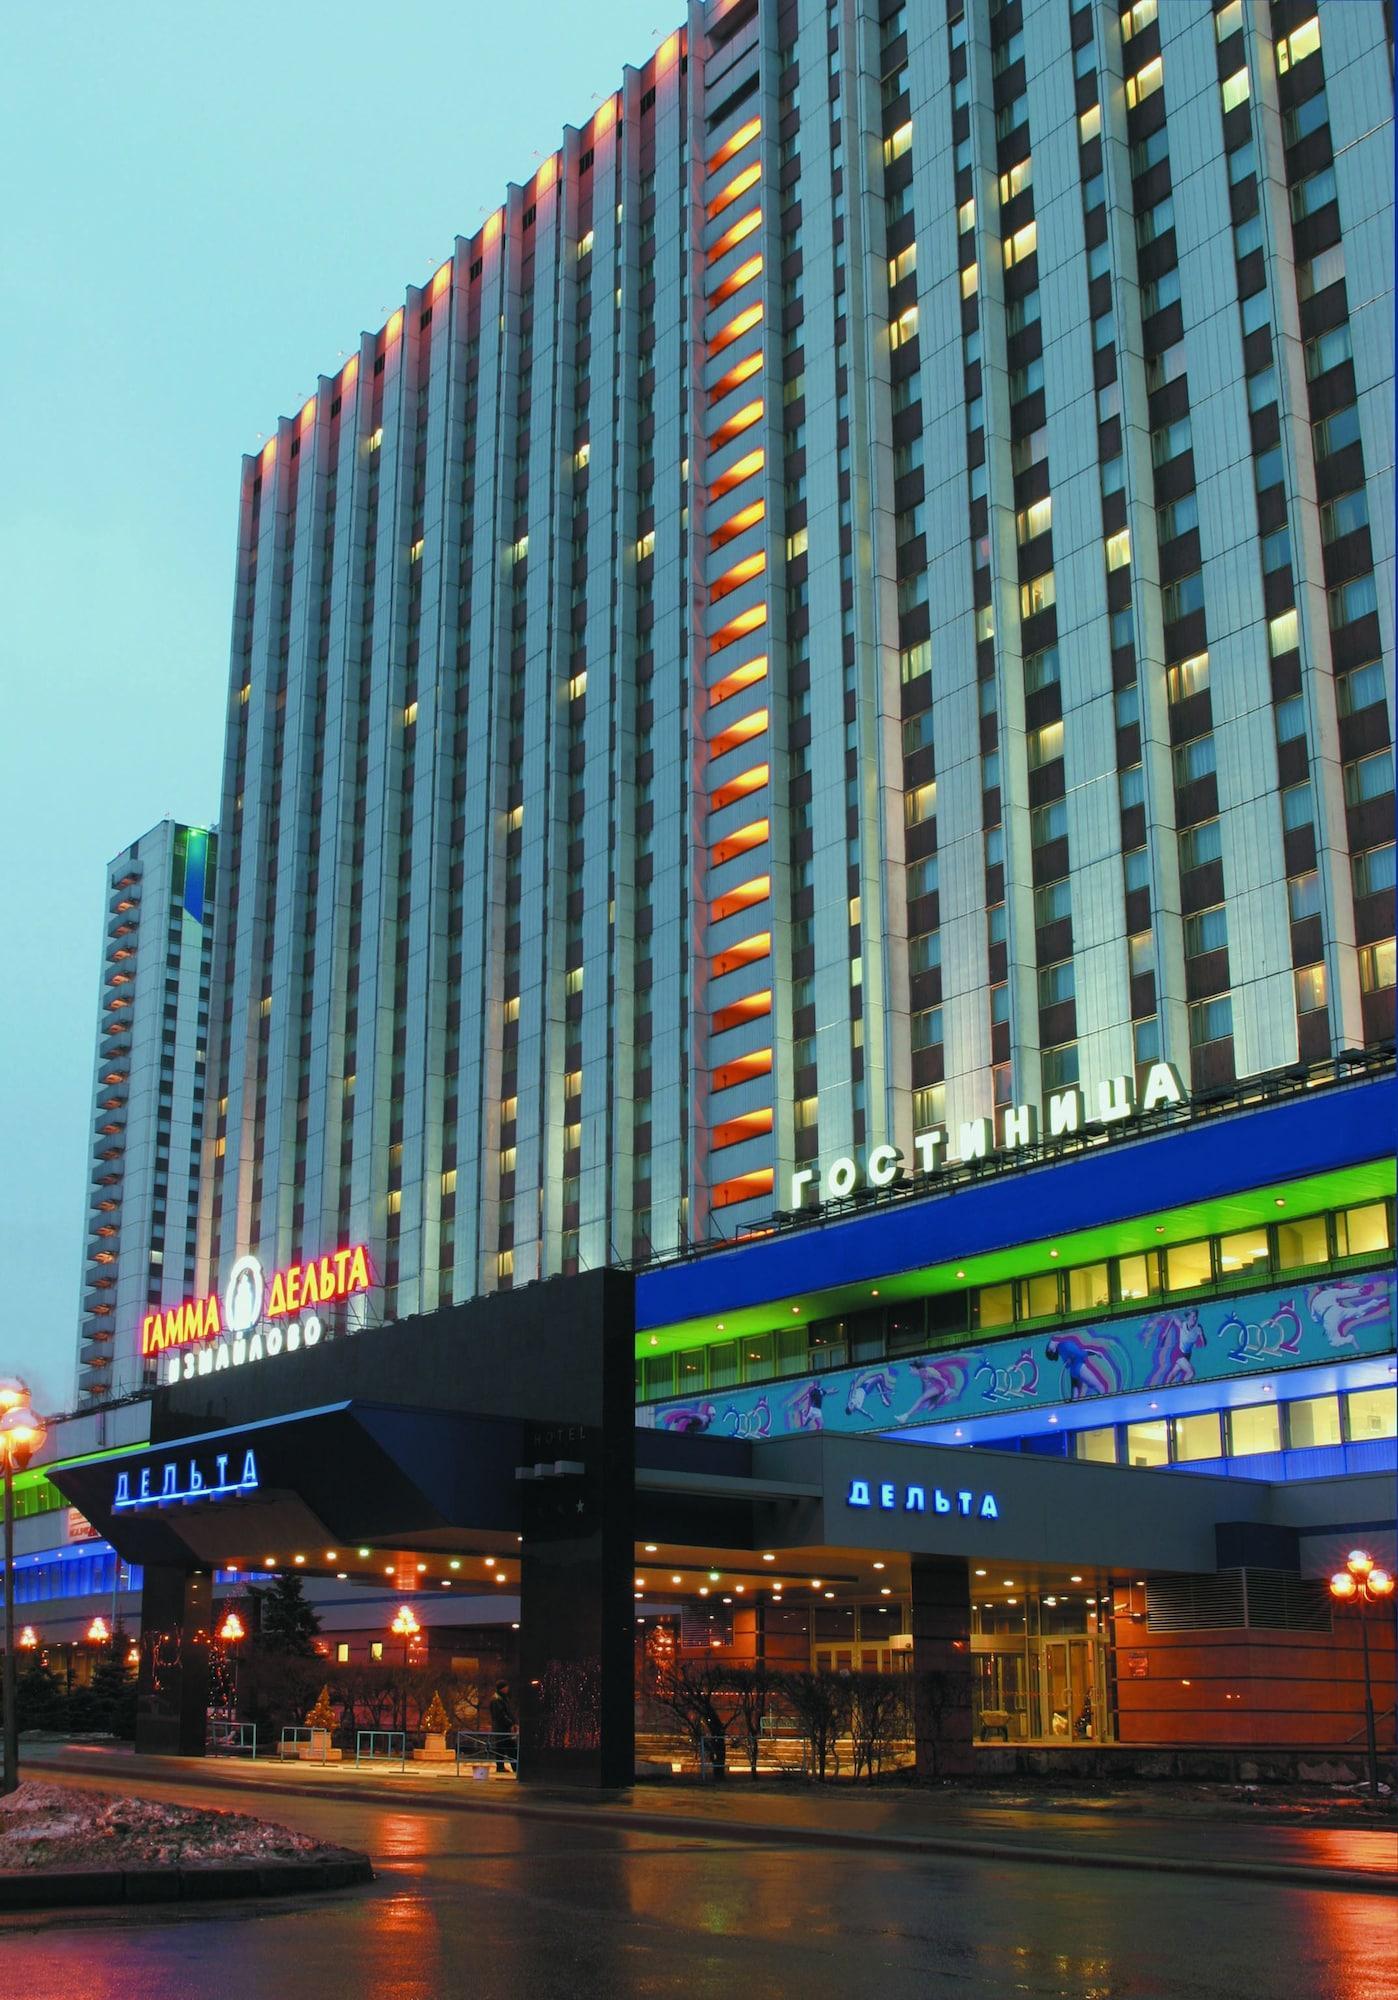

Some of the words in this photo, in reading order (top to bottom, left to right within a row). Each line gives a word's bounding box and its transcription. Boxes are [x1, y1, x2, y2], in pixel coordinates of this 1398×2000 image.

[792, 1062, 1184, 1209] ГОСТИНИЦА
[142, 1295, 220, 1354] ГАММА
[267, 1246, 369, 1317] ДЕЛЬТА
[168, 1316, 322, 1384] ИЗМАЙЛОВО
[534, 1424, 586, 1448] HOTEL
[114, 1449, 257, 1503] ДЕЛЬТА
[848, 1480, 999, 1518] ДЕЛЬТА
